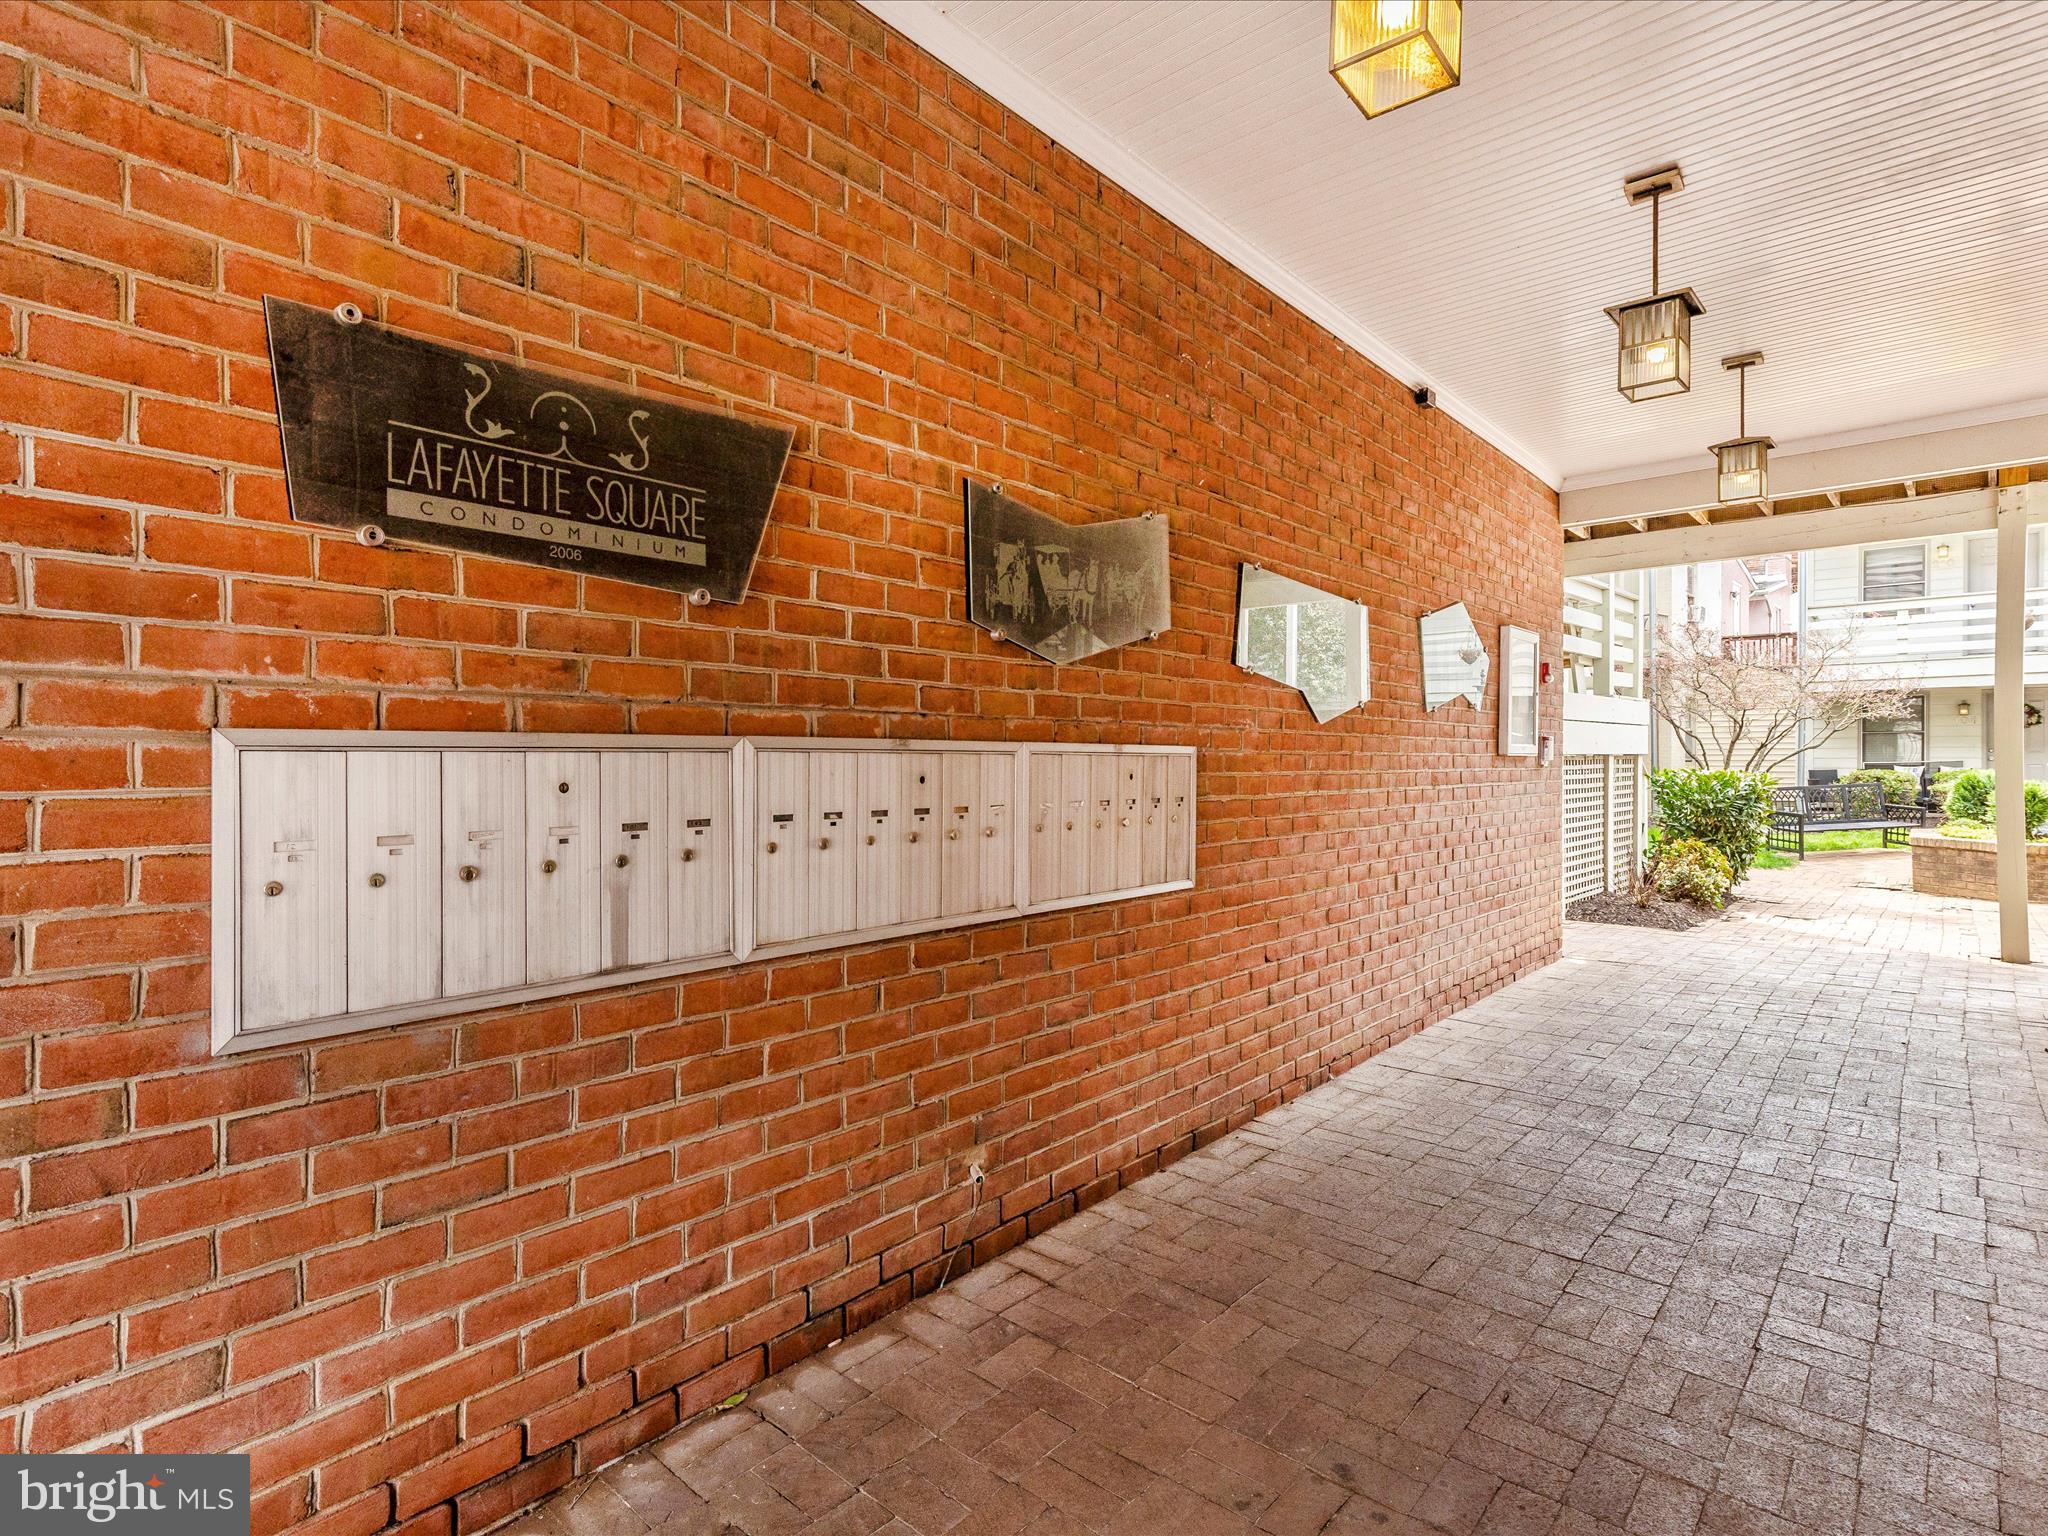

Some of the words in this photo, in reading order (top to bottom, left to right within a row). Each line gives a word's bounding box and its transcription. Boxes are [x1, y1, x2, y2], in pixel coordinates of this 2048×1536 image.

[387, 432, 572, 515] LAFAYETTE
[586, 475, 707, 540] SQUARE
[419, 500, 687, 558] CONDOMINIUM
[549, 544, 583, 562] 2006
